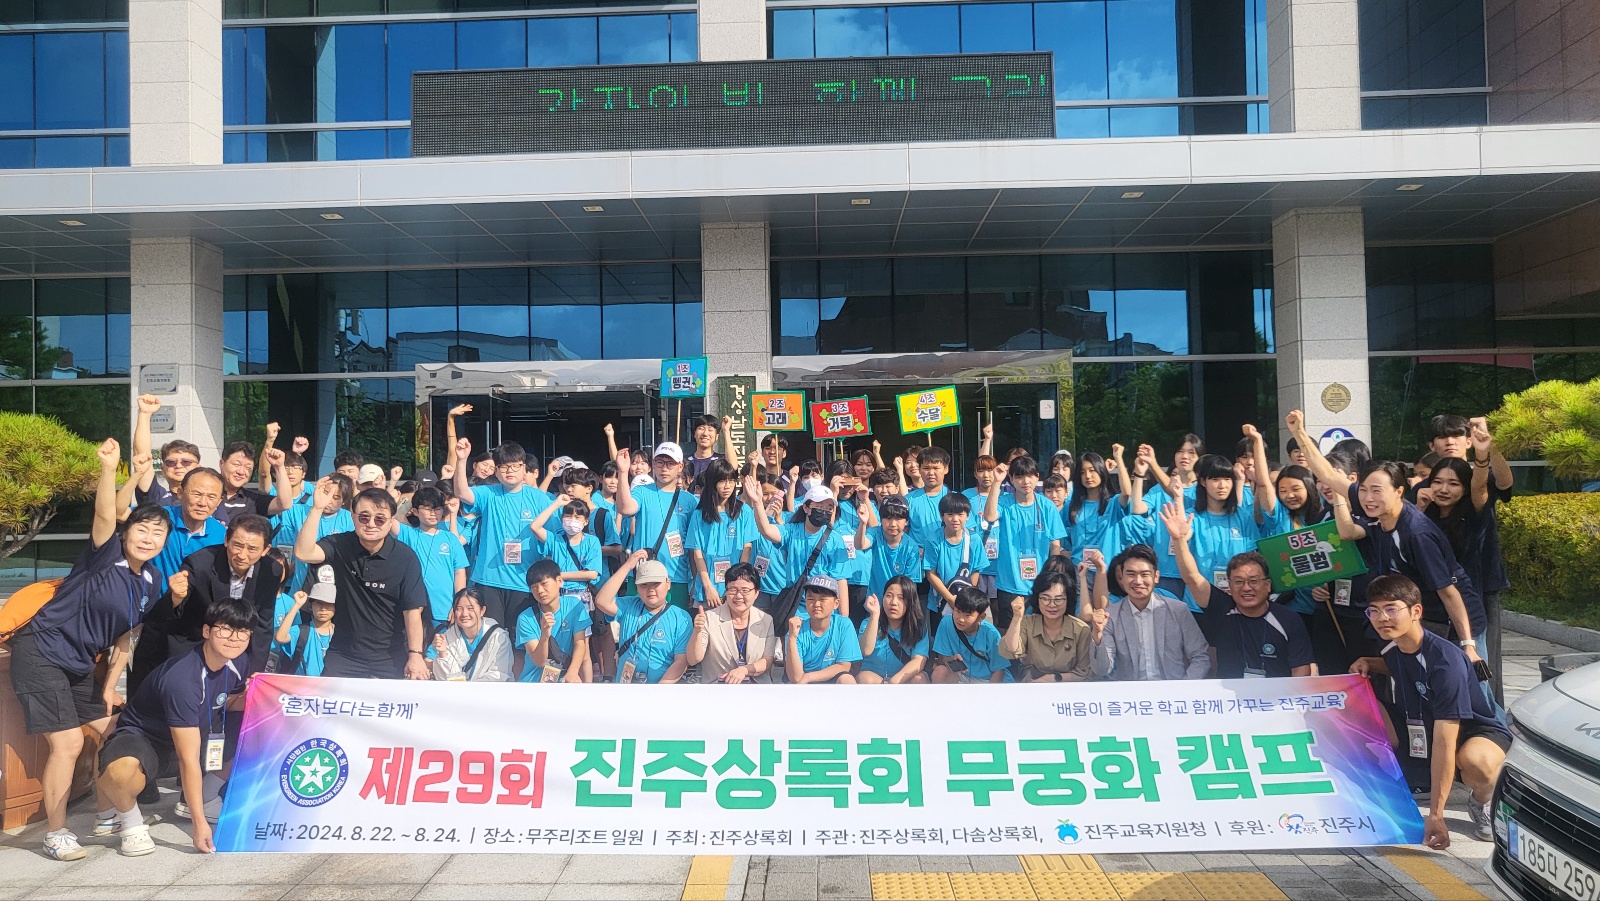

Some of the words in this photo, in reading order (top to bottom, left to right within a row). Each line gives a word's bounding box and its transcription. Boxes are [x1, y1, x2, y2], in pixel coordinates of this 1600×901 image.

[769, 399, 786, 409] 2조
[919, 393, 936, 404] 4조
[832, 403, 849, 413] 3조
[917, 408, 941, 422] 수달
[765, 412, 787, 425] 고래
[829, 416, 851, 430] 거북
[1289, 531, 1317, 549] 5조
[1291, 551, 1330, 575] 물범
[1106, 701, 1155, 717] 즐거운
[1158, 700, 1189, 715] 학교
[1192, 699, 1224, 715] 함께
[1227, 698, 1275, 714] 가꾸는
[358, 746, 547, 809] 제29회
[569, 737, 924, 810] 진주상록회
[946, 736, 1161, 807] 무궁화
[1175, 731, 1335, 802] 캠프
[1084, 820, 1207, 840] 진주교육지원청
[1318, 815, 1376, 834] 진주시
[1563, 860, 1600, 901] 259
